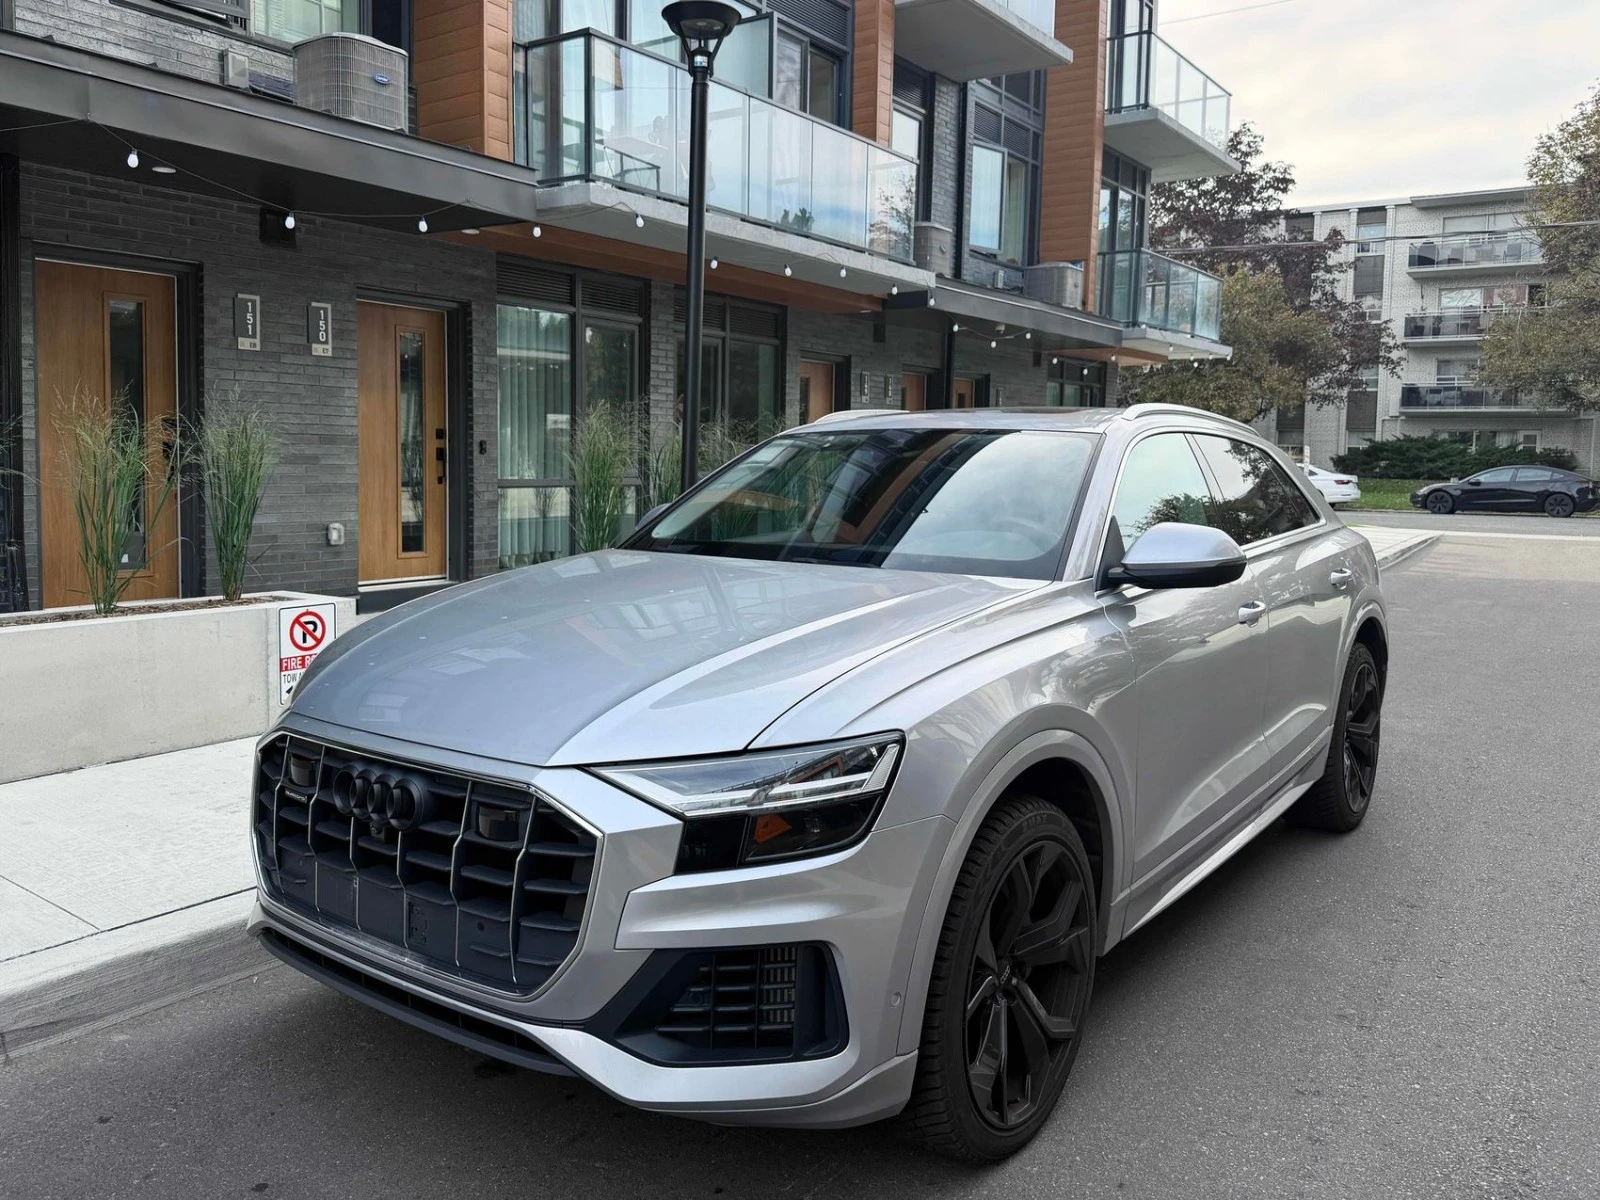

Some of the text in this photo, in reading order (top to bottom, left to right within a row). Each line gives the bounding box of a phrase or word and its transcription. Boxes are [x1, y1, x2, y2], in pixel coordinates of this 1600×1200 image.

[246, 302, 254, 335] 151
[282, 656, 302, 671] FIRE
[283, 673, 297, 684] TOW
